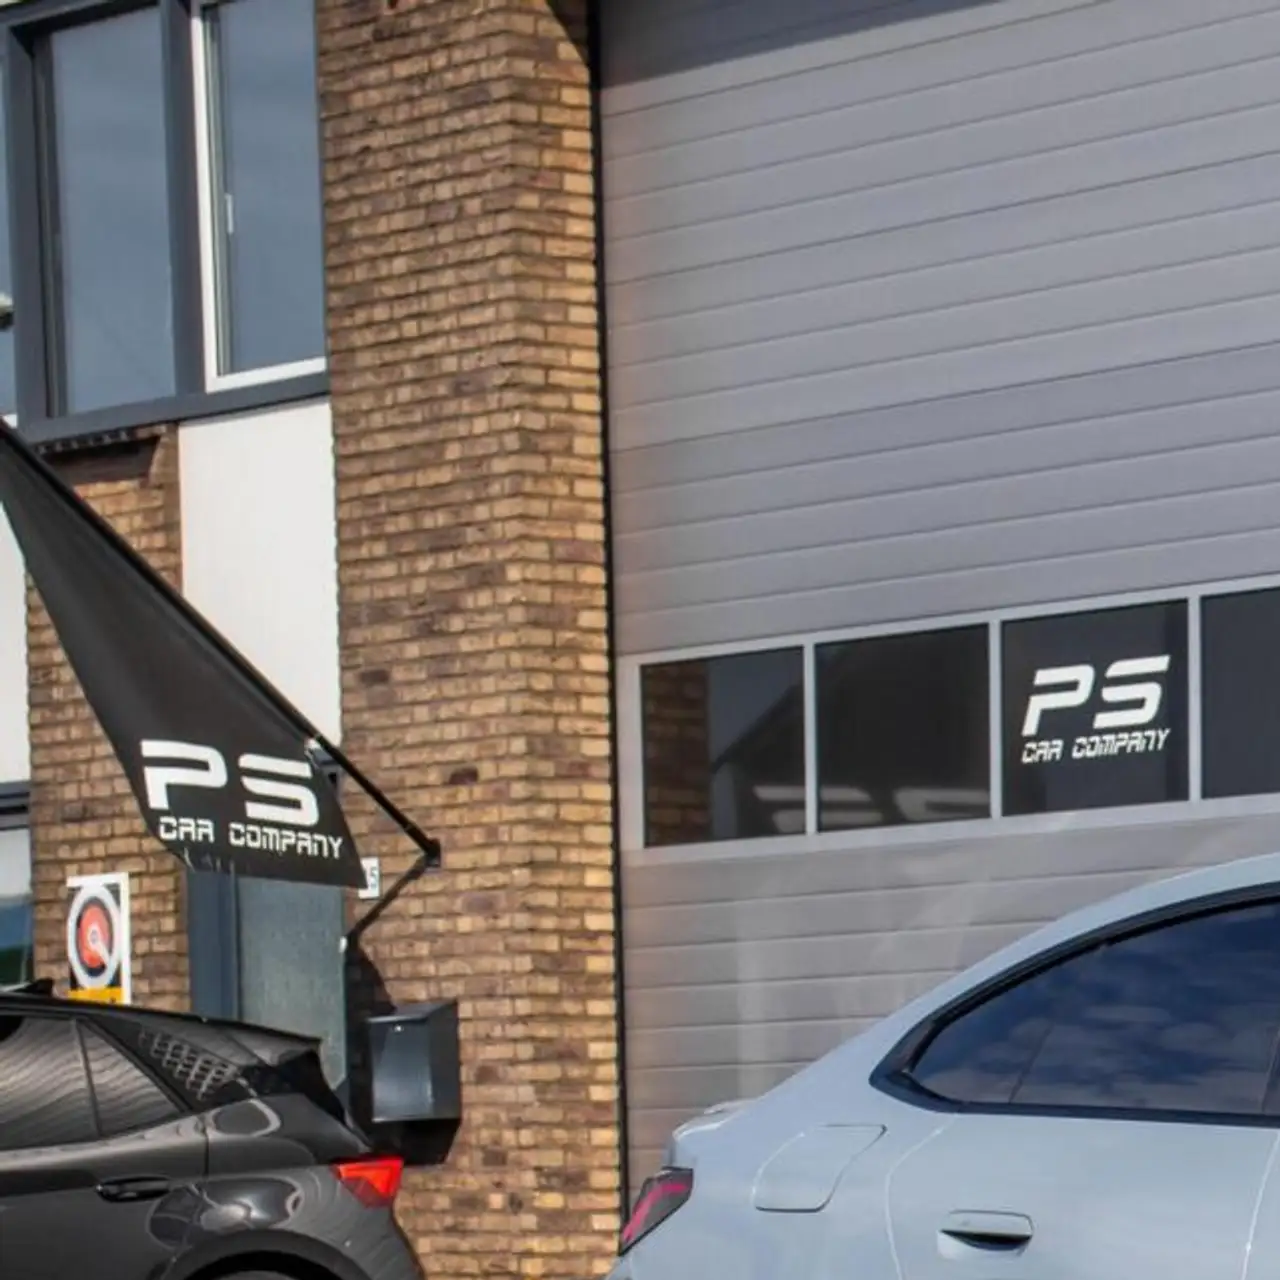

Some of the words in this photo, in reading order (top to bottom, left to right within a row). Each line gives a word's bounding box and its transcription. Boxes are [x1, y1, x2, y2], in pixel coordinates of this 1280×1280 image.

[1021, 654, 1171, 737] PS
[1021, 739, 1064, 764] CAR
[1071, 728, 1170, 759] COMPANY
[140, 739, 320, 827] PS
[159, 815, 215, 843] CAR
[229, 822, 344, 859] COMPANY
